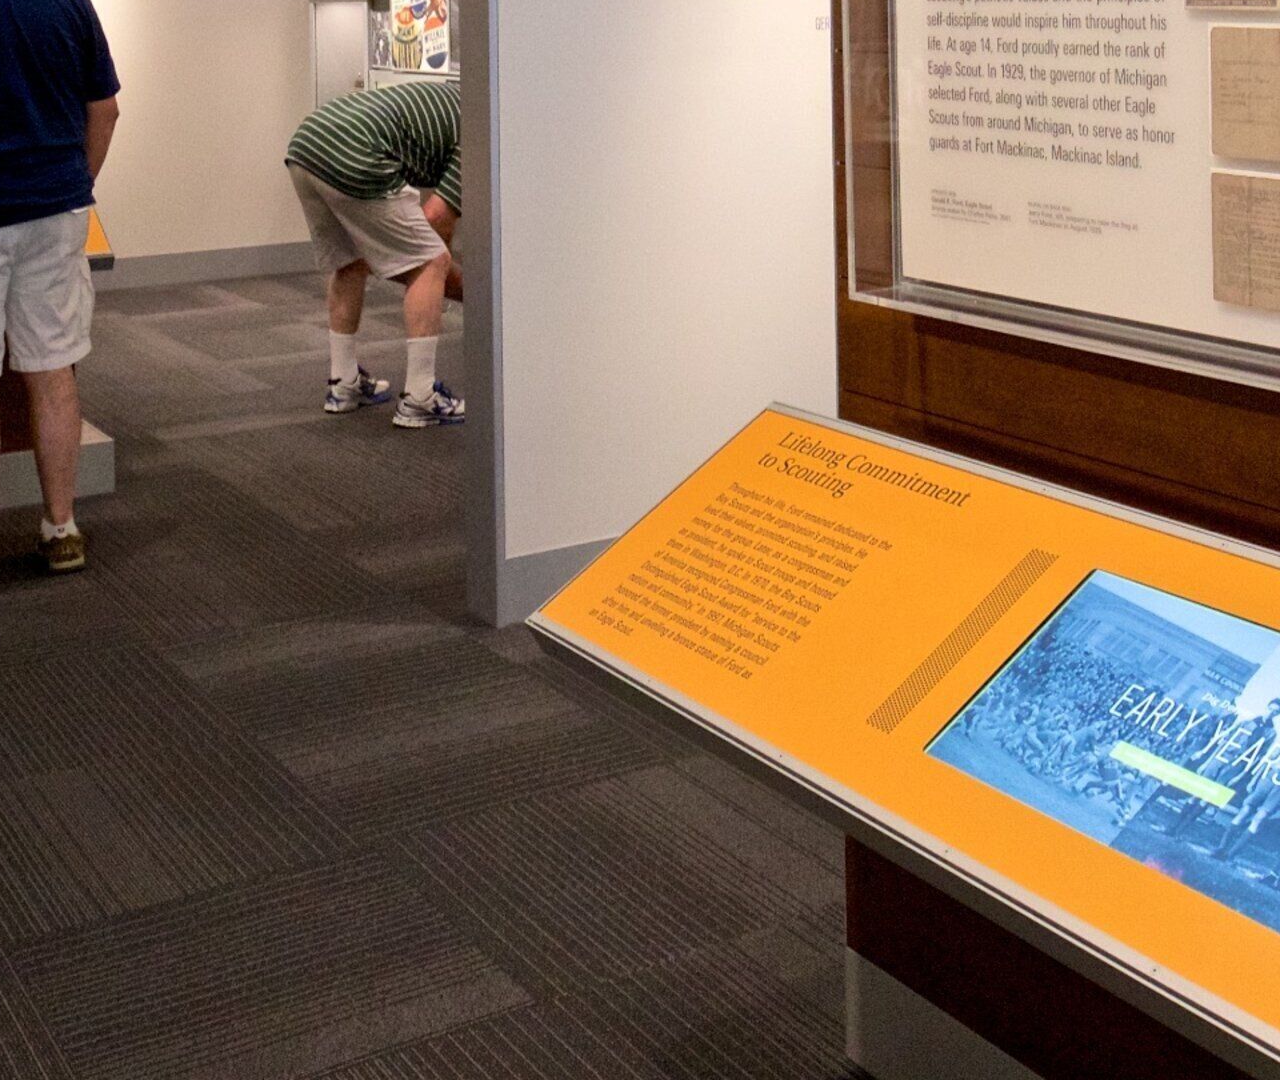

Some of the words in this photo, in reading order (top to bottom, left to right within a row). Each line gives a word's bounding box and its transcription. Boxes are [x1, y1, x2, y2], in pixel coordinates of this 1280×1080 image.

[927, 11, 988, 29] self-discipline
[991, 12, 1021, 29] would
[1024, 13, 1058, 31] inspire
[1062, 14, 1081, 29] him
[1085, 14, 1147, 34] throughout
[1150, 14, 1167, 31] his
[946, 37, 957, 52] At
[960, 40, 977, 56] age
[997, 38, 1018, 54] Ford
[1022, 39, 1060, 57] proudly
[1063, 41, 1100, 58] earned
[1103, 41, 1121, 58] the
[1125, 42, 1150, 59] rank
[1154, 42, 1165, 60] of
[927, 61, 952, 79] Eagle
[987, 63, 997, 78] In
[1030, 64, 1046, 81] the
[1050, 67, 1095, 85] governor
[1099, 66, 1110, 85] of
[1114, 68, 1168, 90] Michigan
[928, 85, 966, 101] selected
[969, 86, 992, 104] Ford,
[996, 89, 1022, 109] along
[1025, 90, 1048, 107] with
[1052, 94, 1089, 110] several
[1092, 95, 1121, 112] other
[1125, 97, 1155, 118] Eagle
[928, 110, 959, 127] Scouts
[962, 111, 984, 127] from
[987, 114, 1020, 131] around
[1024, 116, 1074, 138] Michigan,
[1078, 120, 1089, 137] to
[1092, 125, 1122, 139] serve
[1125, 126, 1138, 140] as
[1142, 126, 1175, 145] honor
[929, 136, 960, 152] guards
[963, 137, 971, 152] at
[975, 137, 994, 153] Fort
[997, 140, 1048, 161] Mackinac,
[1051, 145, 1102, 165] Mackinac
[1106, 149, 1142, 169] Island.
[757, 452, 777, 468] to
[777, 458, 854, 499] Scouting
[778, 431, 847, 469] Lifelong
[846, 454, 971, 508] Commitment
[1109, 684, 1209, 742] EARLY
